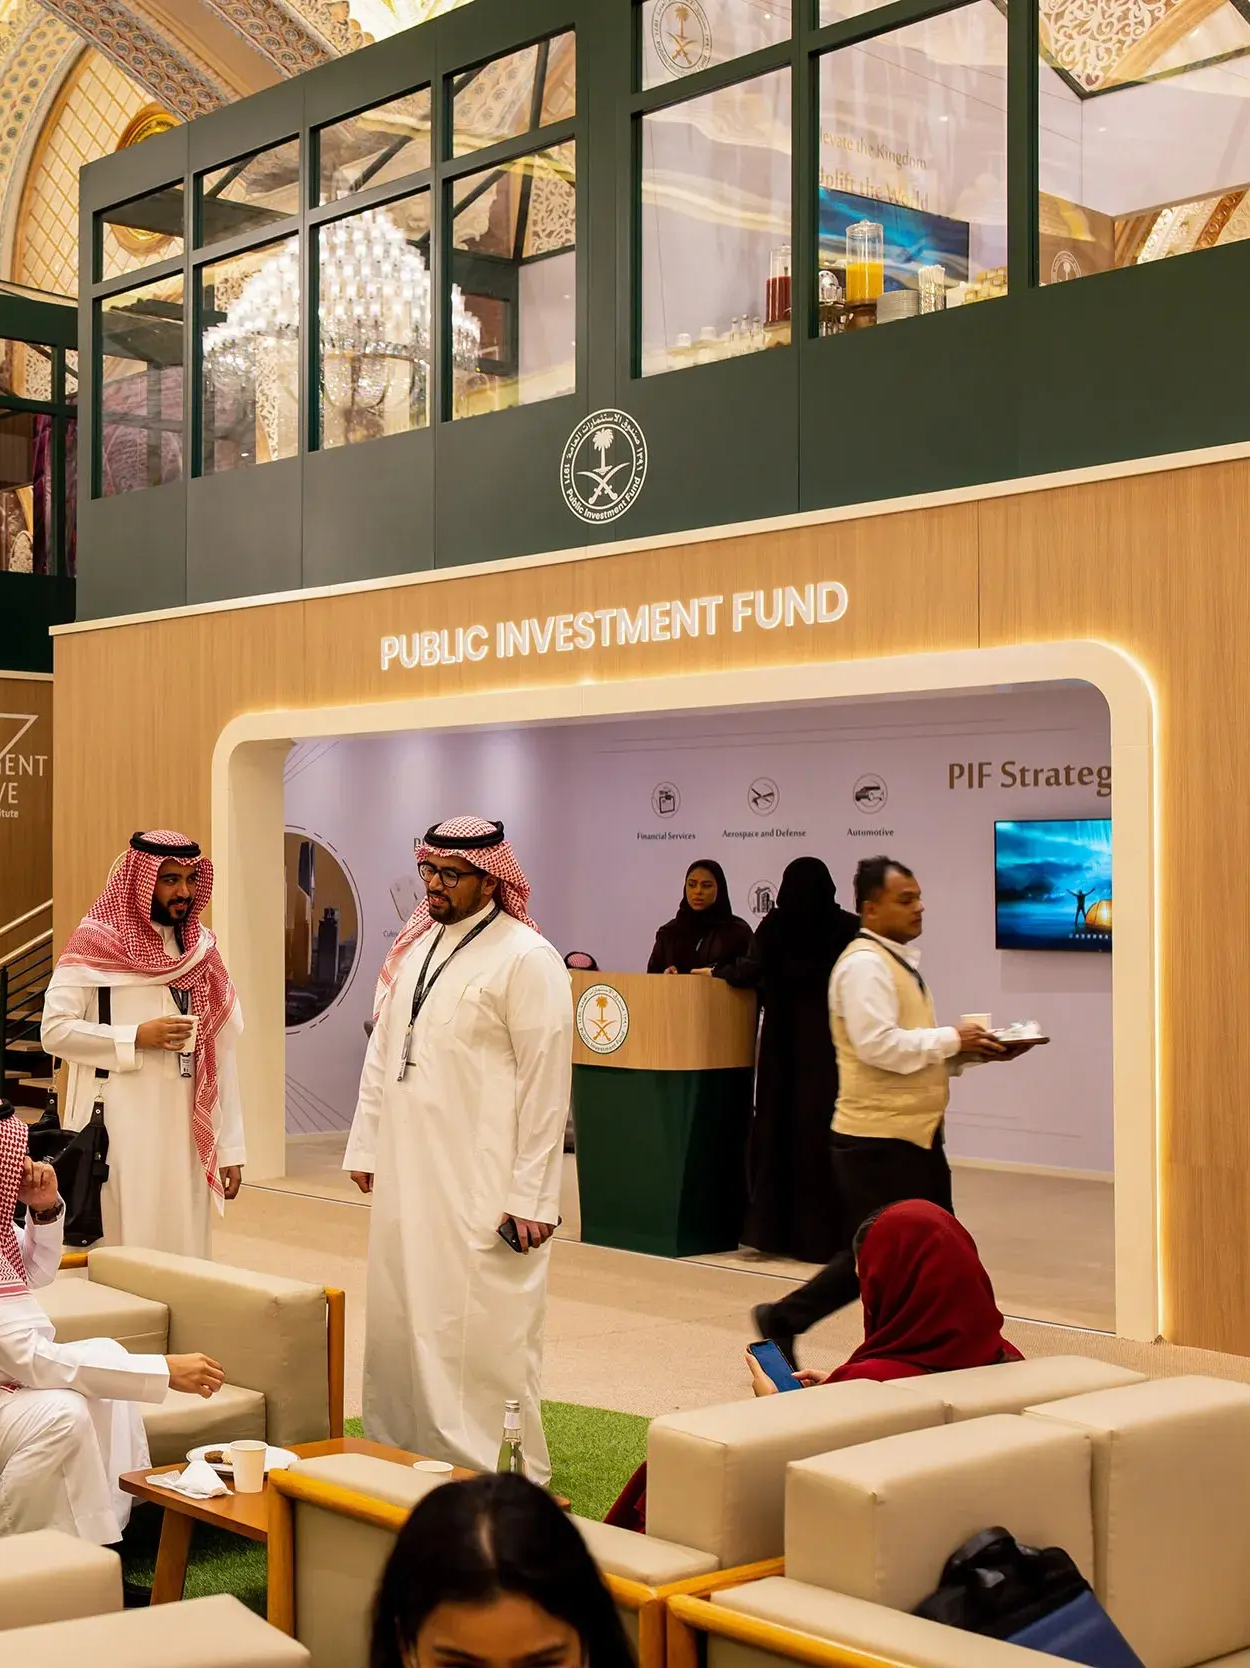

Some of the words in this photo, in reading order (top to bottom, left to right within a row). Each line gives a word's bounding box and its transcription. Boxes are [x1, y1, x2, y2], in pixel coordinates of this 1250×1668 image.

[876, 143, 927, 170] Kingdom
[566, 488, 584, 514] Public
[584, 500, 627, 520] Investment
[625, 476, 641, 502] Fund
[380, 624, 489, 671] PUBLIC
[496, 595, 724, 659] INVESTMENT
[732, 580, 850, 633] FUND
[948, 761, 993, 790] PIF
[999, 760, 1112, 798] Strateg
[636, 831, 667, 841] Financial
[667, 831, 696, 841] Services
[722, 829, 759, 840] Aerospace
[760, 828, 774, 838] and
[775, 828, 806, 838] Defense
[846, 827, 895, 838] Automotive
